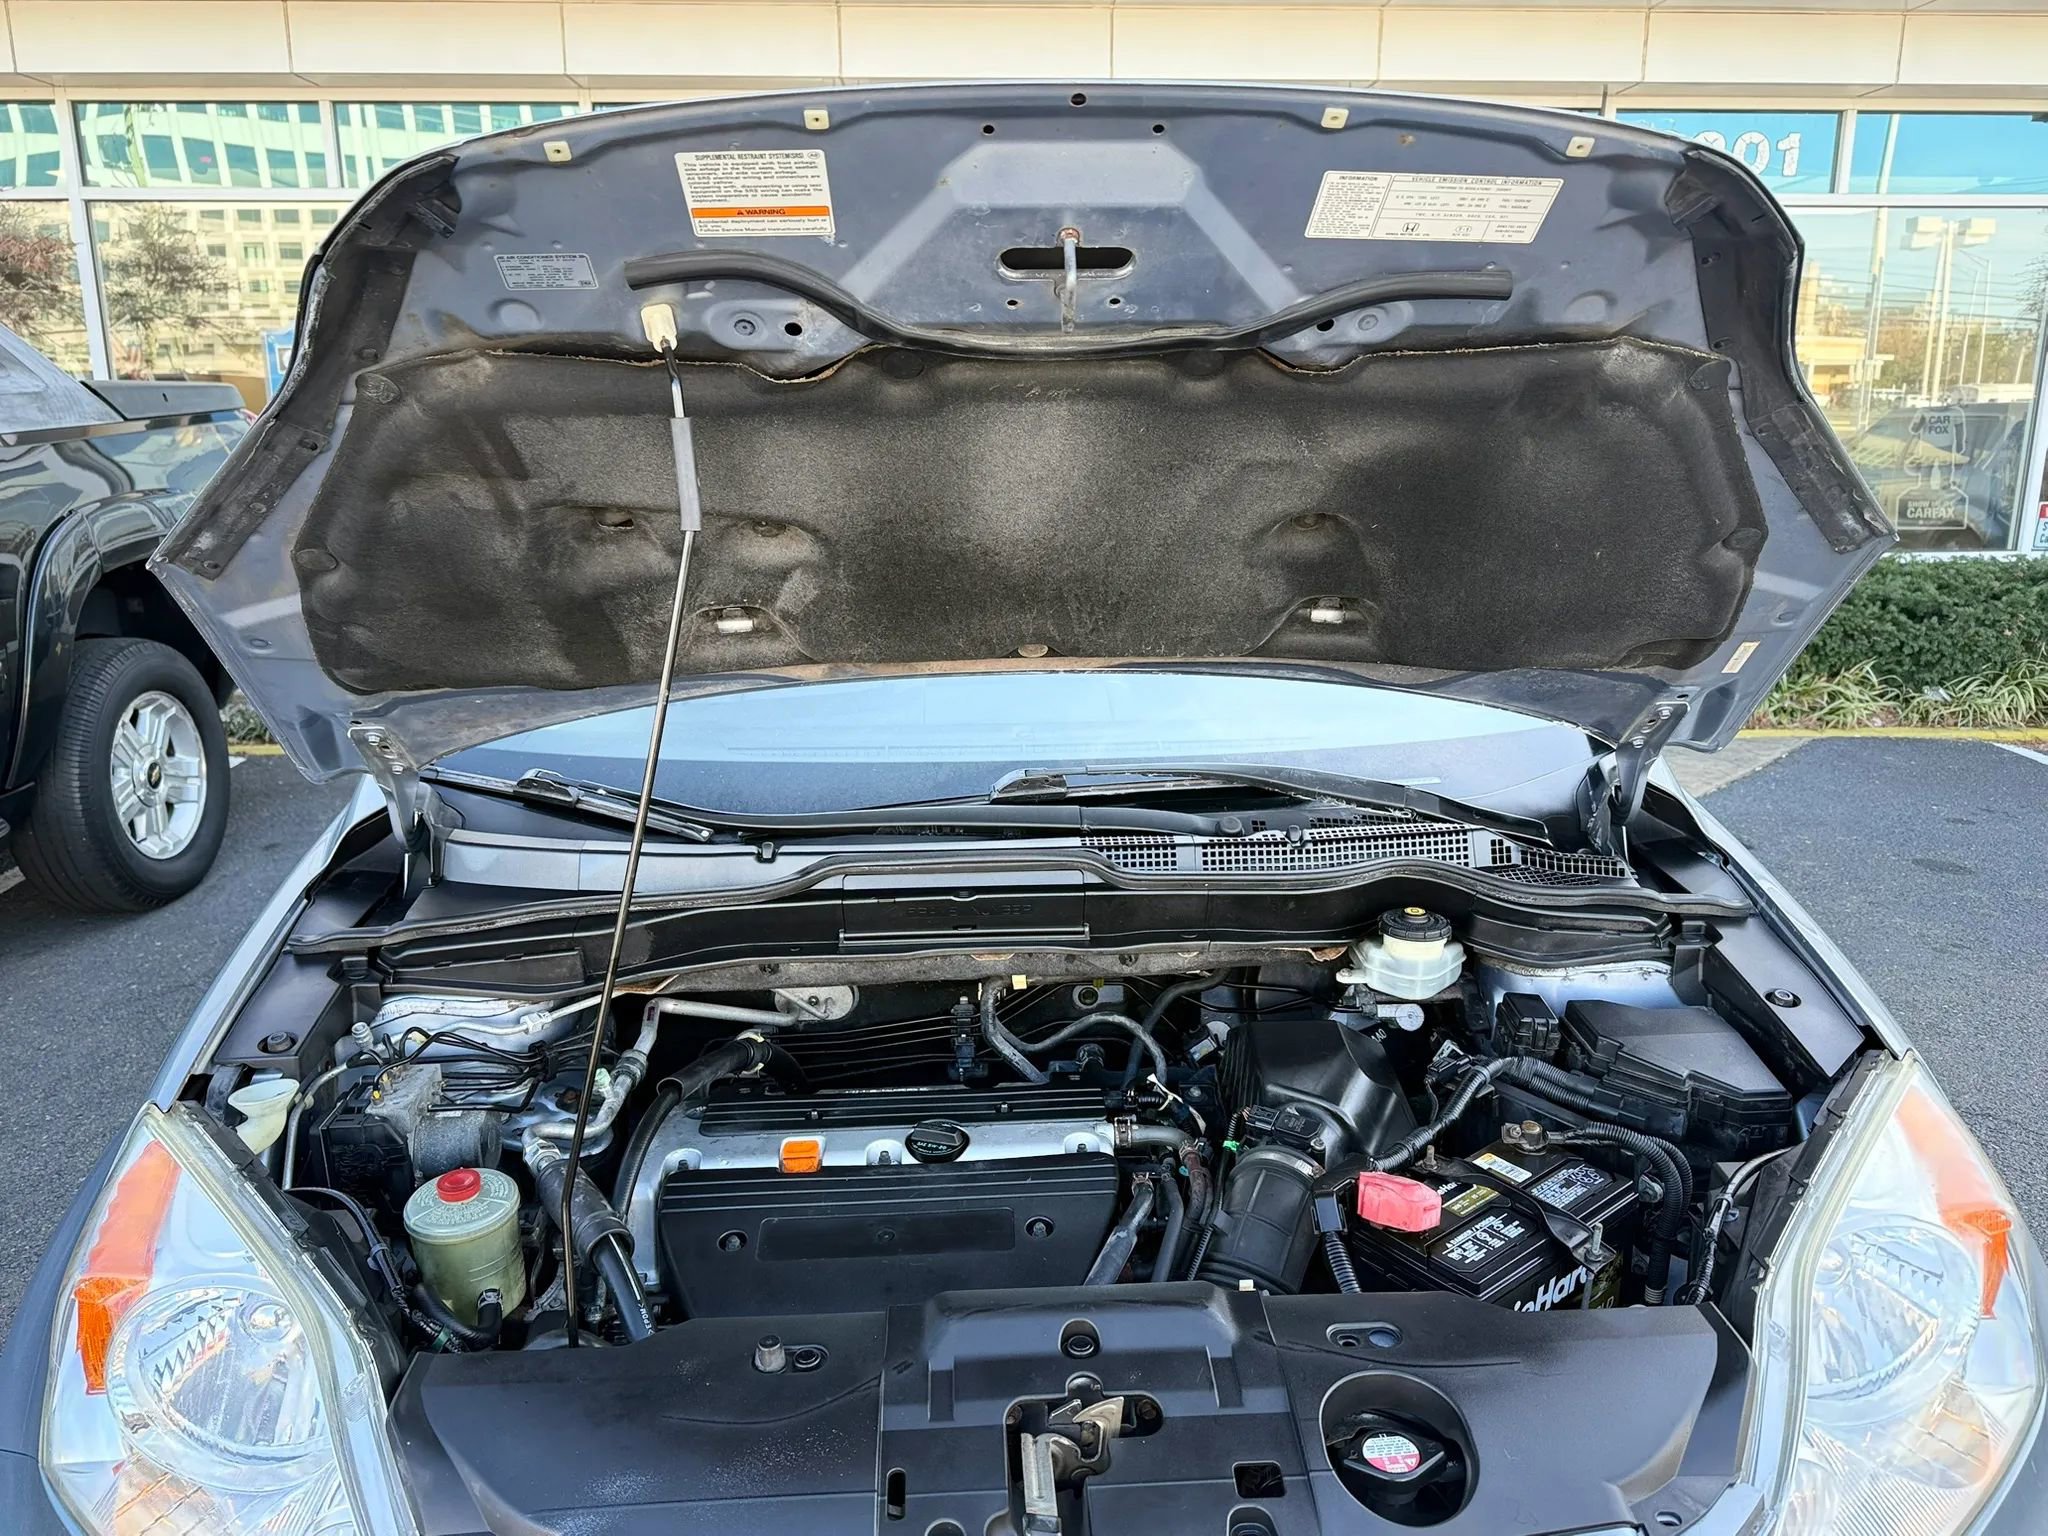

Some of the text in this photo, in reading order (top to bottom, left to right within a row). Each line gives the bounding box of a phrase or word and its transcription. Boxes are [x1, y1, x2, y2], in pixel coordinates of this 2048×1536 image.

[1928, 415, 1951, 425] CAR
[1928, 425, 1949, 434] FOX
[1907, 507, 1954, 519] CARFAX
